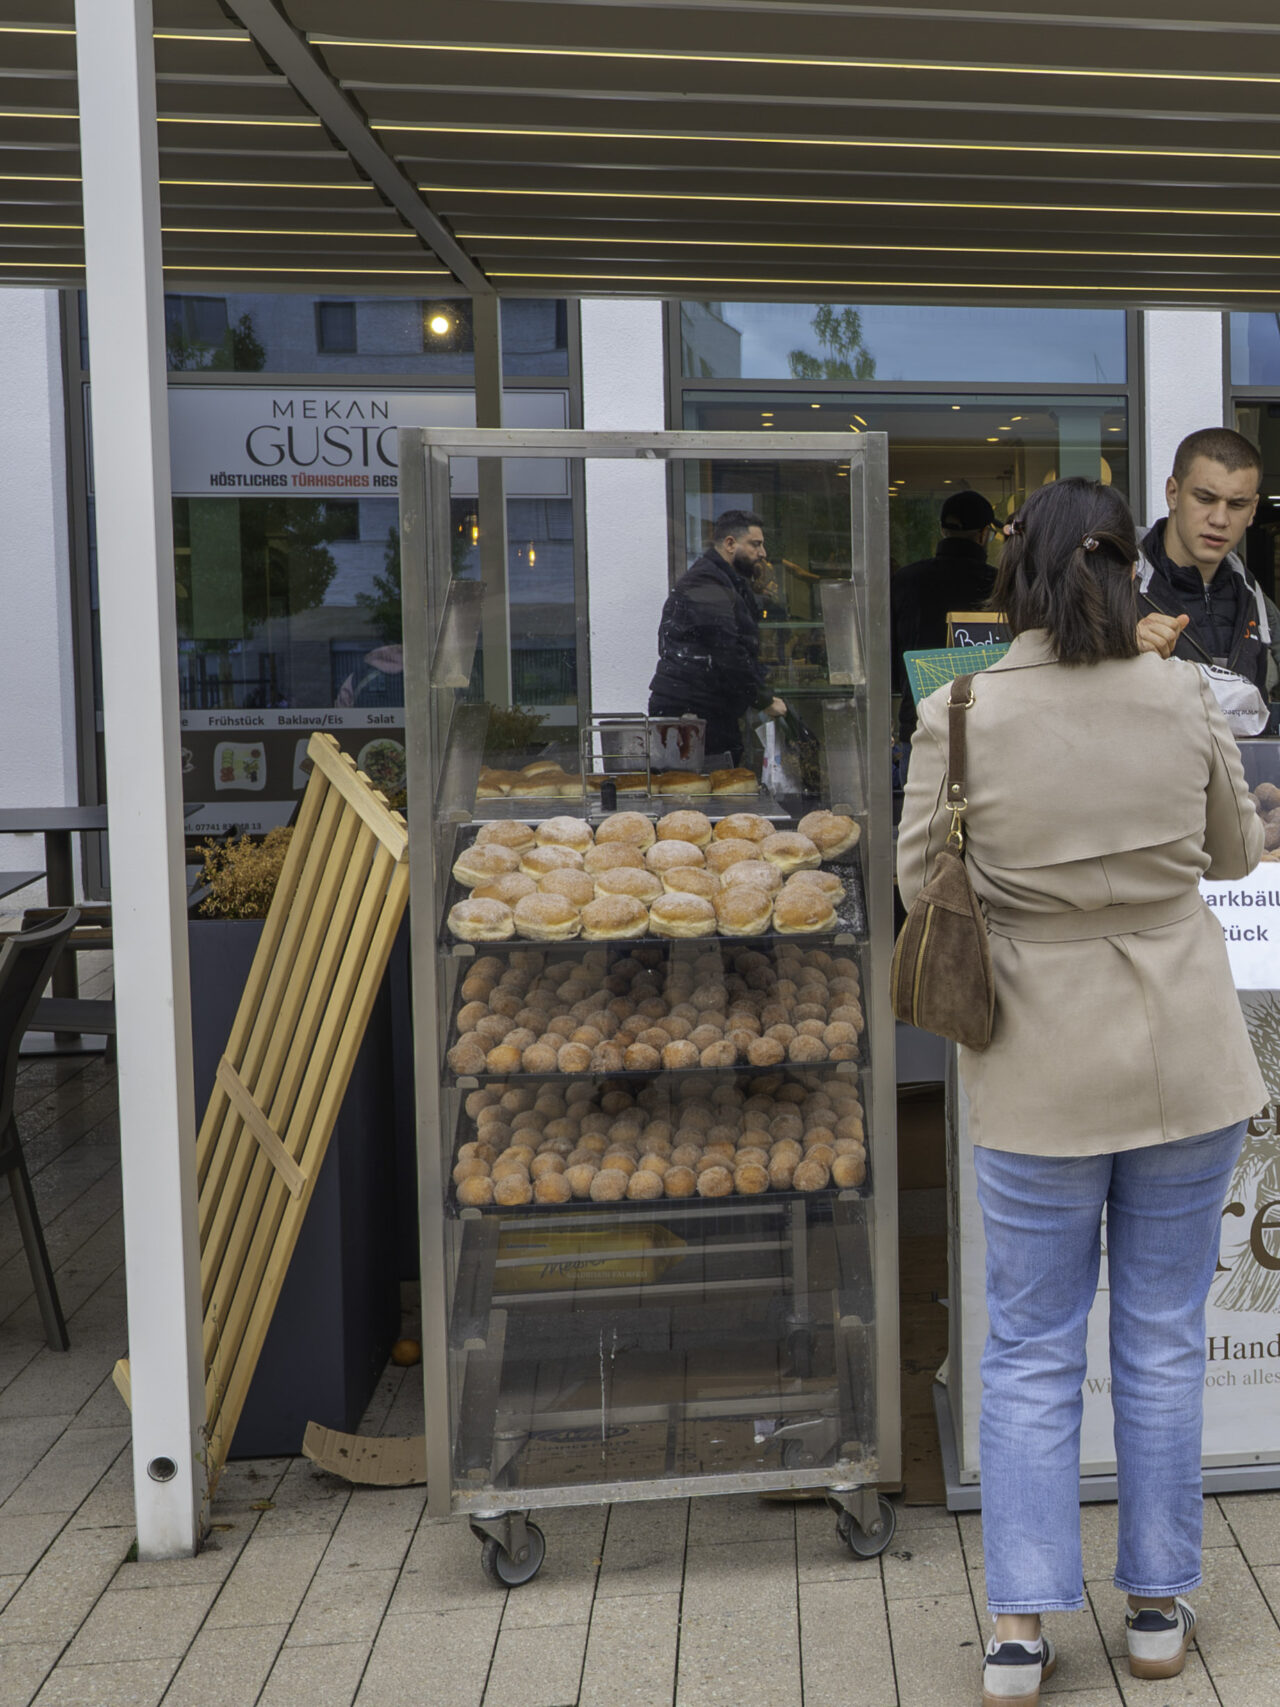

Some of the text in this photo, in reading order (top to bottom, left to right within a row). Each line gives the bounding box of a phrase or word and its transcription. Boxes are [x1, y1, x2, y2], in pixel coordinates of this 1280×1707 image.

[273, 400, 388, 419] MEKAN
[210, 472, 288, 487] KÖSTLICHES
[292, 472, 369, 487] TÜRKISCHES
[209, 714, 394, 726] Frühstück Baklava/Eis Salat
[196, 823, 220, 831] 07741
[1223, 925, 1269, 941] tück
[1087, 1376, 1111, 1395] Wi
[1205, 1370, 1237, 1388] och
